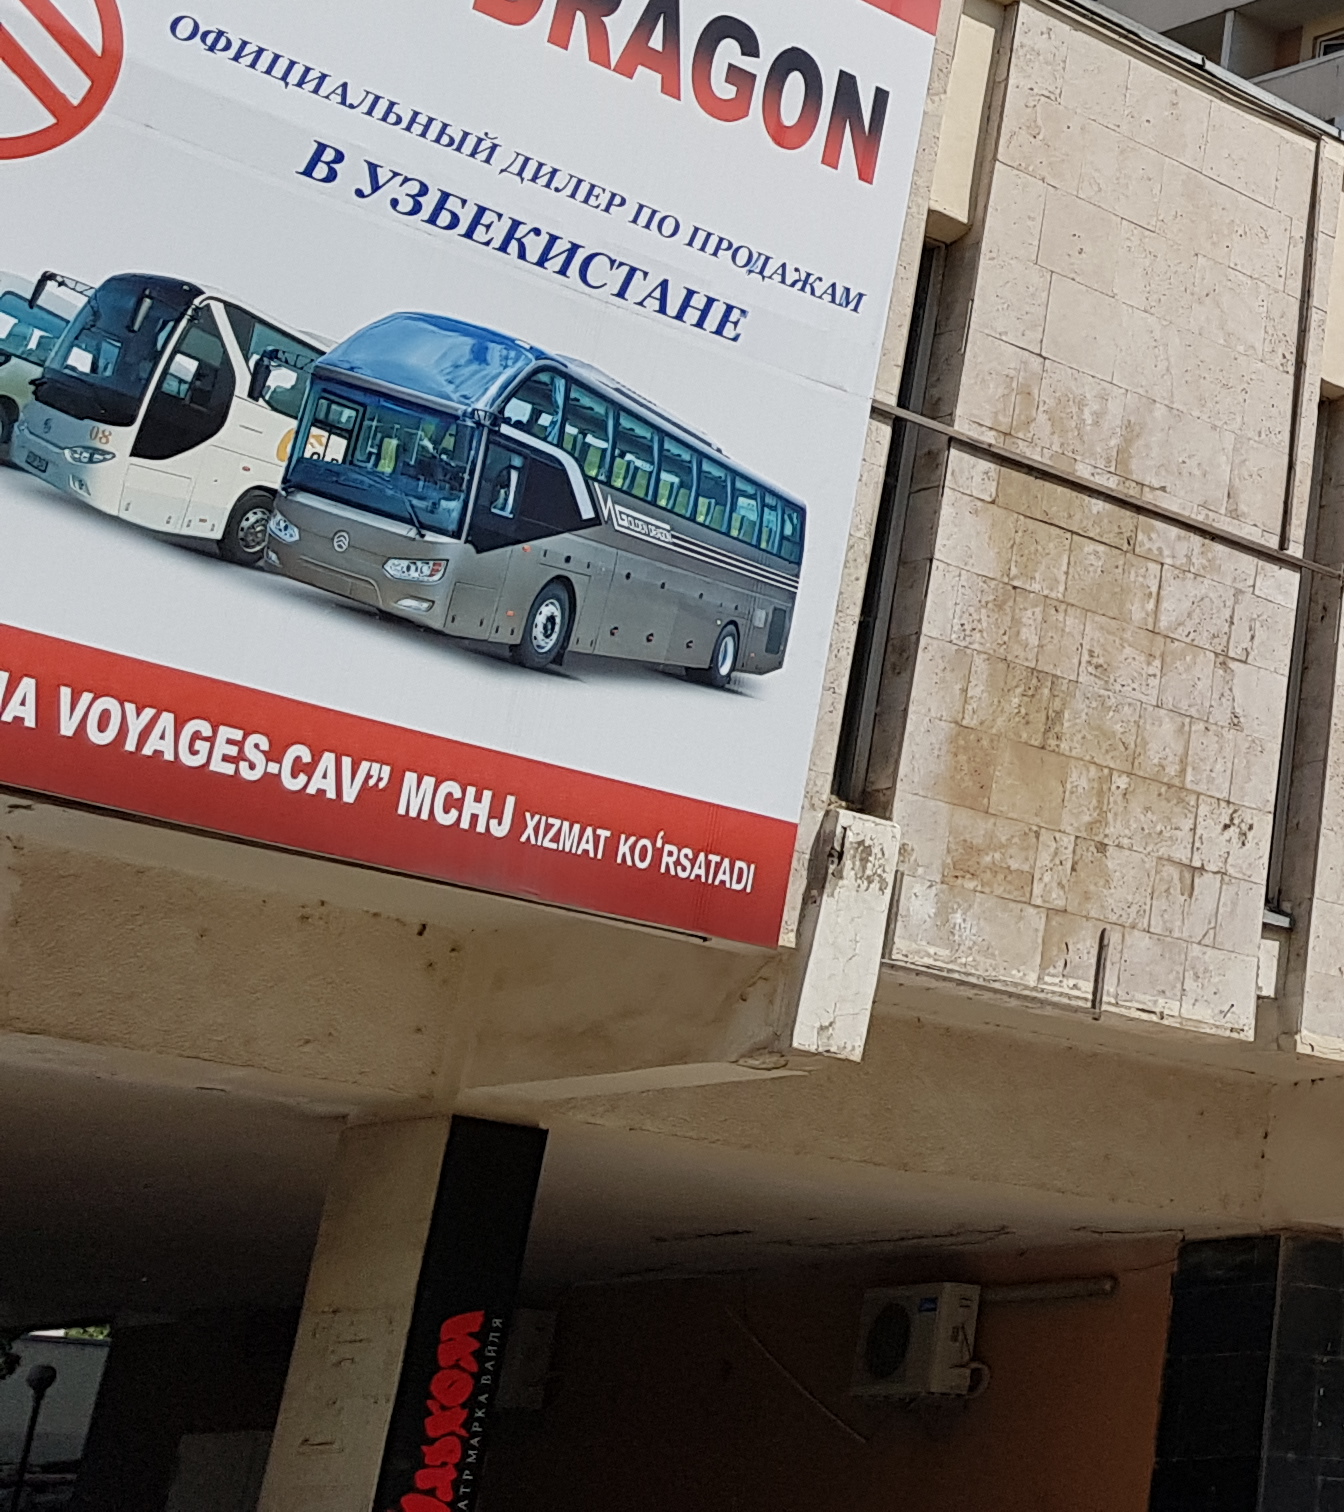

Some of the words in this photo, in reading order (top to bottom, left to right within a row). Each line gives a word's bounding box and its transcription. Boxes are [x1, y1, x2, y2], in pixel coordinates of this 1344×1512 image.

[170, 15, 502, 166] ОФИЦИАЛЬНЫЙ
[498, 151, 626, 215] ДИЛЕР
[628, 202, 680, 238] ПО
[684, 225, 867, 313] ПРОДАЖАМ
[295, 139, 345, 184] В
[354, 159, 749, 343] УЗБЕКИСТАНЕ
[0, 671, 37, 728] A
[397, 771, 516, 837] MCHJ
[519, 812, 611, 860] XIZMAT
[466, 1393, 489, 1463] МАРКА
[481, 1318, 503, 1384] ВАЙЛЯ
